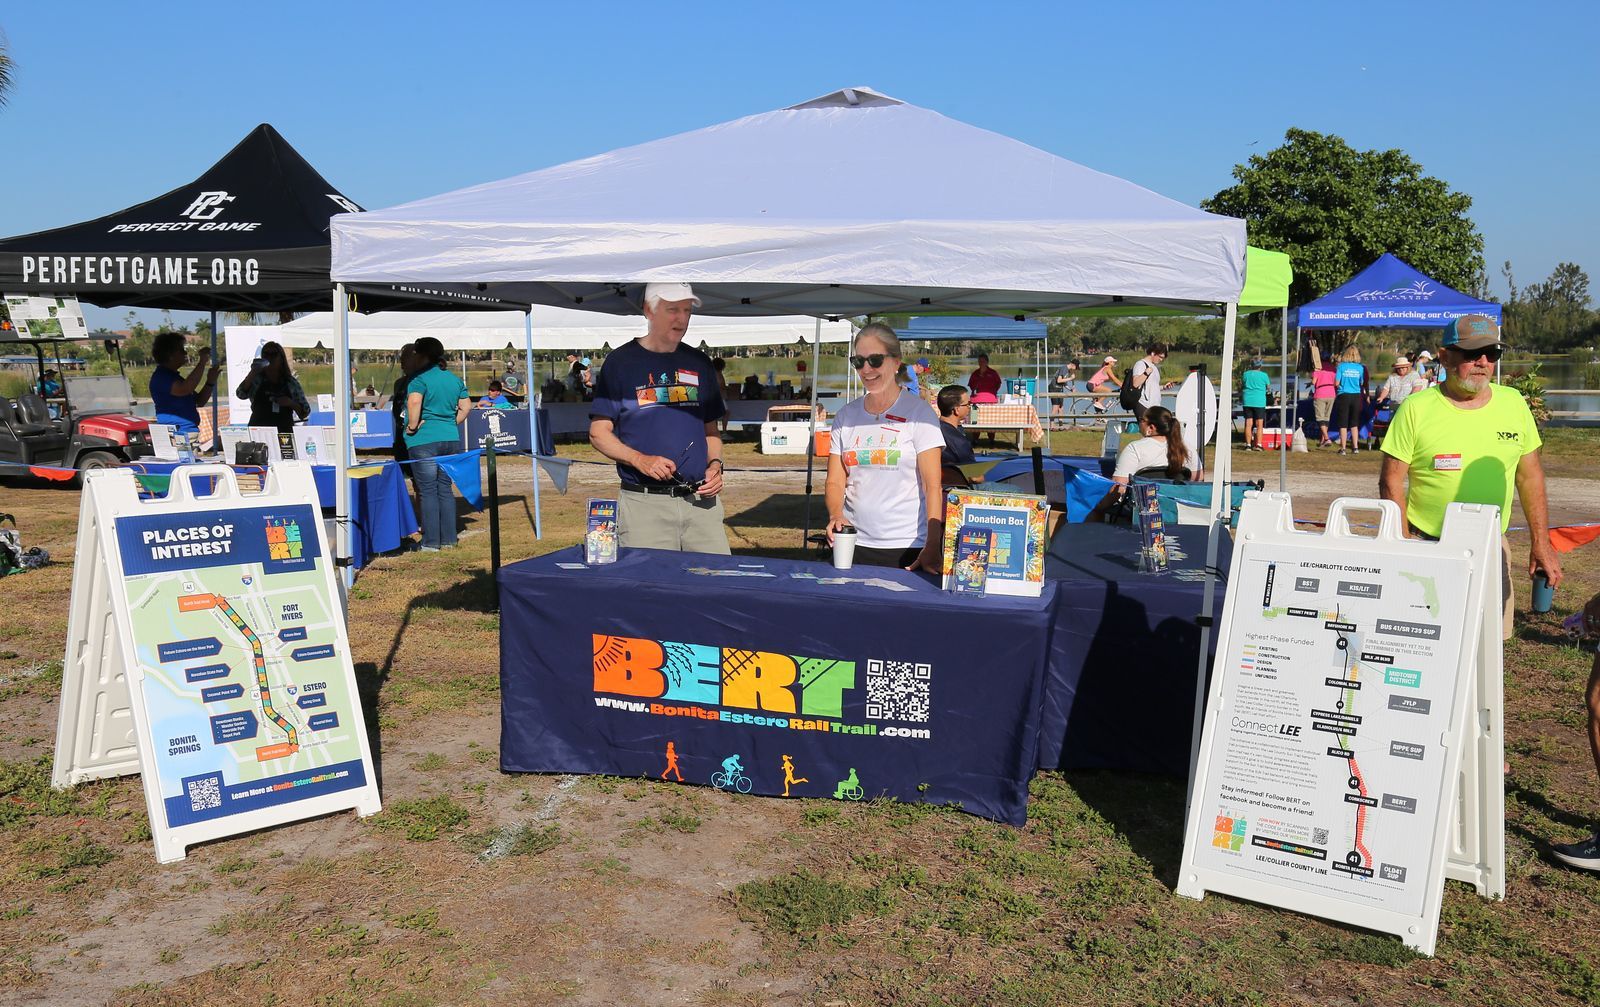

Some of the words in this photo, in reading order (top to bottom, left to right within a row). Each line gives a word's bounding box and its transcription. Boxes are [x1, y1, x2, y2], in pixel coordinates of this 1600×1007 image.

[108, 222, 196, 233] PERFECT
[198, 222, 261, 232] GAME
[22, 257, 259, 285] PERFECTGAME.ORG
[1310, 312, 1349, 320] Enhancing
[1388, 311, 1426, 319] Enriching
[1497, 432, 1518, 441] NPC
[843, 450, 901, 466] BERT
[968, 514, 1006, 524] Donation
[1008, 517, 1024, 525] Box
[143, 525, 210, 544] PLACES
[211, 524, 234, 538] OF
[152, 540, 232, 560] INTEREST
[1300, 562, 1342, 571] LEE/CHARLOTTE
[283, 604, 298, 612] FORT
[281, 612, 303, 621] MYERS
[1291, 637, 1314, 646] Funded
[1380, 640, 1407, 648] ALIGNMENT
[592, 633, 856, 718] BERT
[1389, 670, 1417, 679] MIDTOWN
[304, 682, 326, 691] ESTERO
[1232, 717, 1278, 733] Connect
[1279, 724, 1302, 736] LEE
[169, 735, 197, 746] BONITA
[169, 744, 201, 756] SPRINGS
[232, 792, 249, 800] Learn
[250, 788, 265, 796] More
[273, 770, 348, 791] BonitaEsteroRailTrail.com
[1221, 784, 1234, 793] Stay
[1235, 785, 1264, 797] informed!
[1266, 793, 1285, 801] Follow
[1286, 795, 1300, 804] BERT
[1220, 794, 1248, 804] facebook
[1262, 800, 1286, 811] become
[1293, 806, 1314, 816] friend!
[1256, 855, 1290, 867] LEE/COLLIER
[1291, 863, 1314, 872] COUNTY
